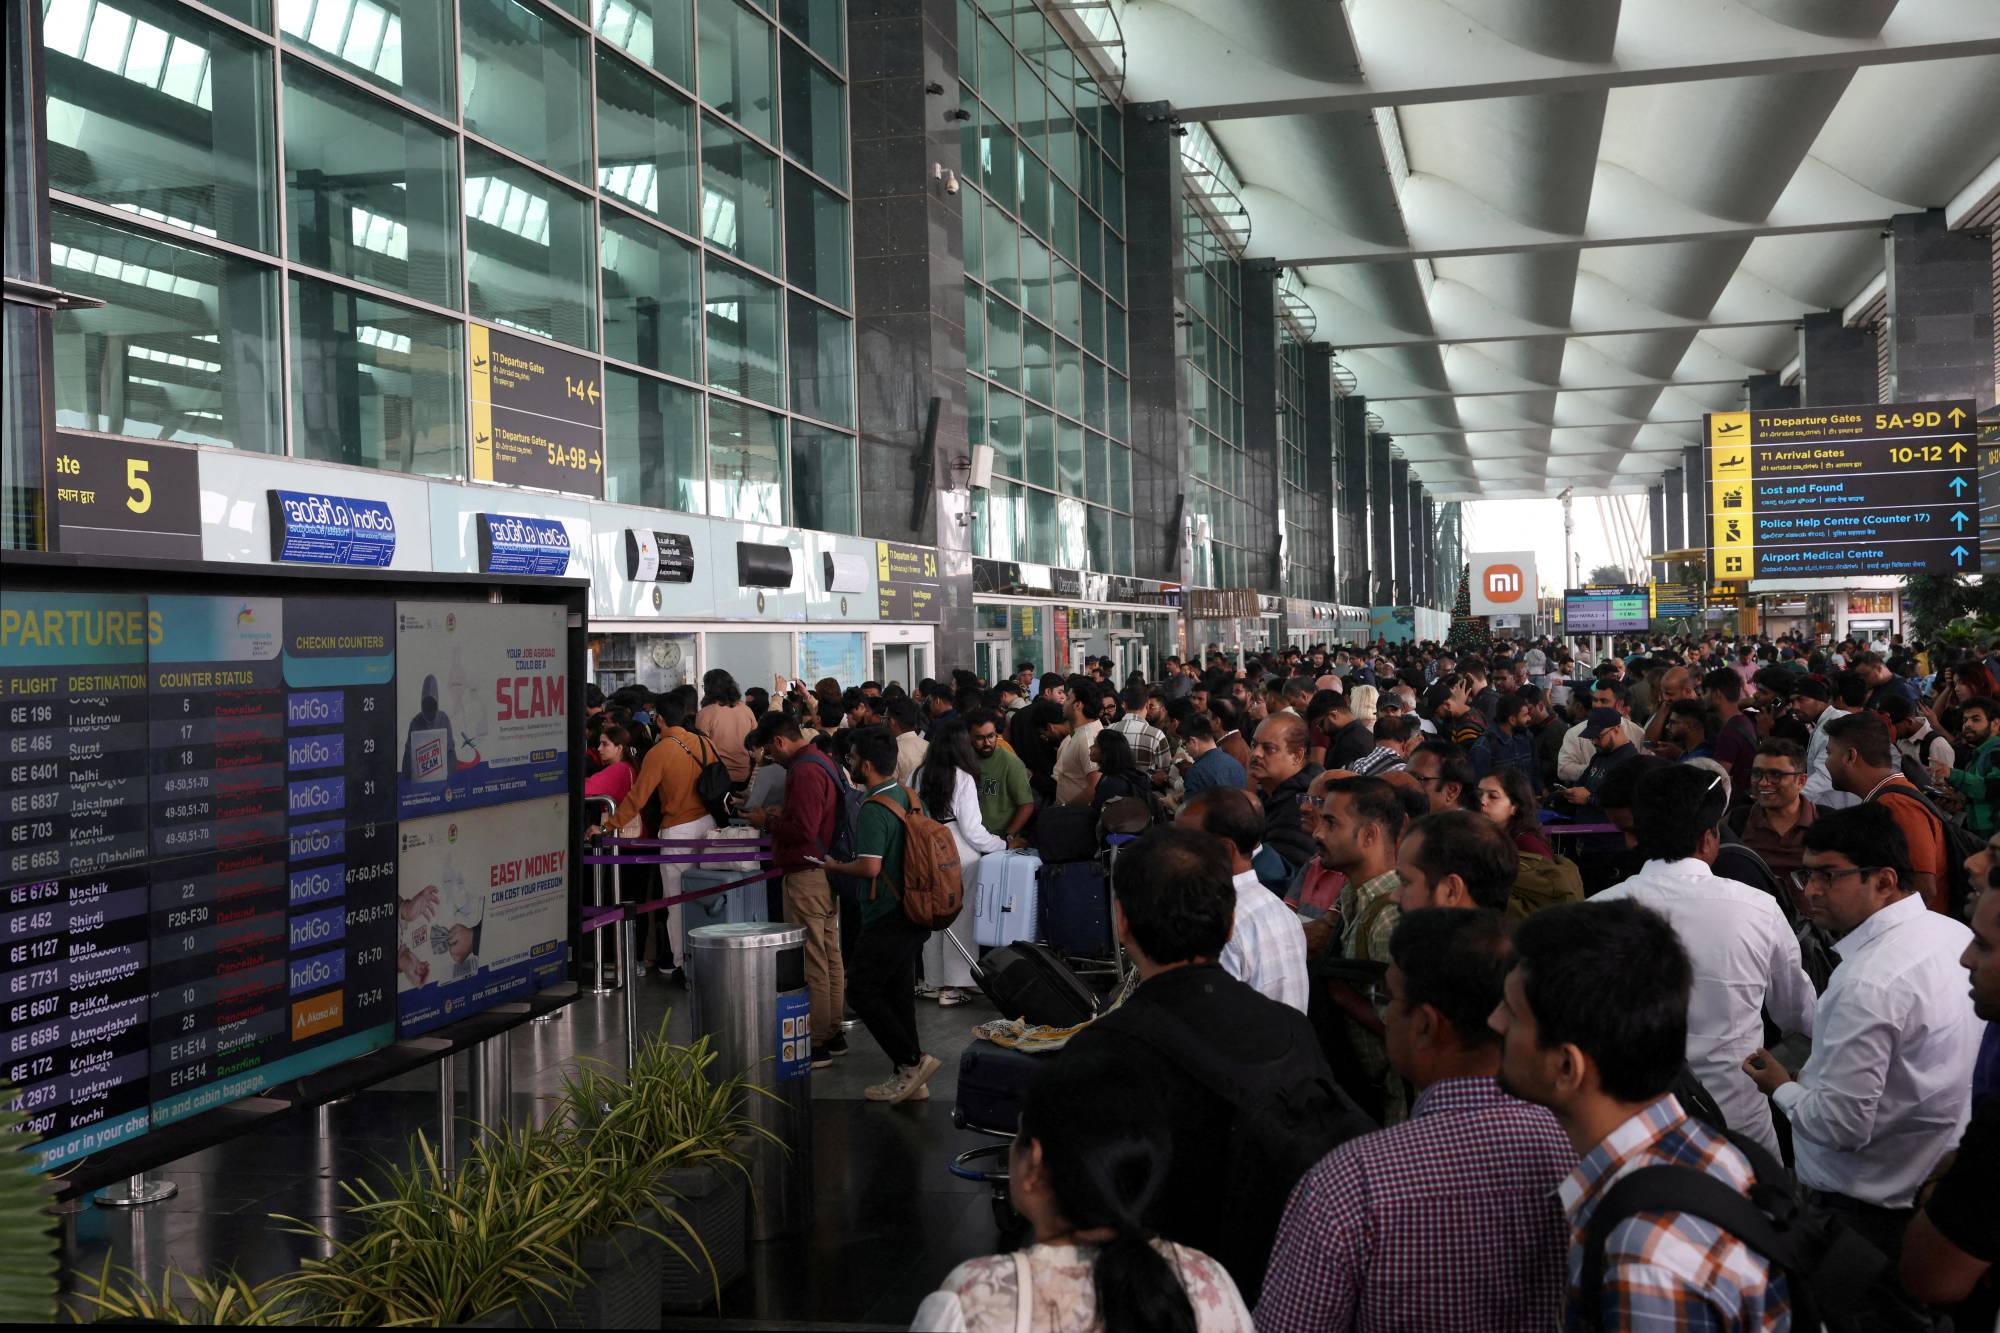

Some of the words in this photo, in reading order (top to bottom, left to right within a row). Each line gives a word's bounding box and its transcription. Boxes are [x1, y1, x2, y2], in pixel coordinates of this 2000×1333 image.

[492, 351, 500, 362] T1
[500, 353, 528, 370] Departure
[529, 361, 545, 375] Gates
[566, 376, 585, 401] 1-4
[1759, 418, 1771, 428] T1
[1774, 416, 1828, 429] Departure
[1830, 414, 1862, 425] Gates
[1875, 411, 1941, 430] 5A-9D
[495, 427, 502, 438] T1
[502, 429, 531, 445] Departure
[531, 435, 547, 447] Gates
[547, 443, 587, 471] 5A-9B
[1760, 450, 1772, 461] T1
[1776, 449, 1811, 460] Arrival
[1813, 448, 1845, 459] Gates
[1889, 446, 1943, 464] 10-12
[79, 489, 96, 504] द्वार
[126, 458, 153, 515] 5
[1760, 485, 1784, 496] Lost
[1786, 484, 1807, 494] and
[1809, 482, 1844, 493] Found
[350, 507, 393, 531] IndiGo
[1760, 518, 1793, 529] Police
[1795, 517, 1820, 529] Help
[1823, 516, 1860, 527] Centre
[1863, 514, 1911, 527] (Counter
[1913, 512, 1931, 525] 17)
[536, 527, 568, 547] IndiGo
[923, 552, 938, 578] 5A
[1761, 552, 1800, 565] Airport
[1802, 550, 1844, 562] Medical
[1847, 549, 1884, 560] Centre
[655, 592, 660, 605] 3
[295, 636, 336, 650] CHECKIN
[337, 635, 385, 649] COUNTERS
[506, 647, 521, 659] YOUR
[516, 660, 535, 671] COULD
[11, 677, 58, 696] FLIGHT
[68, 673, 147, 693] DESTINATION
[159, 672, 212, 689] COUNTER
[214, 670, 254, 687] STATUS
[363, 697, 375, 712] 25
[496, 674, 566, 721] SCAM
[11, 708, 27, 724] 6E
[30, 706, 53, 722] 196
[289, 698, 329, 721] IndiGo
[180, 725, 193, 739] 17
[11, 739, 27, 754] 6E
[30, 736, 53, 752] 465
[289, 741, 329, 763] IndiGo
[363, 739, 375, 754] 29
[180, 751, 193, 766] 18
[421, 757, 439, 773] SCAM
[11, 767, 27, 783] 6E
[30, 763, 59, 780] 6401
[165, 776, 209, 793] 49-50,51-70
[364, 781, 375, 795] 31
[11, 797, 27, 813] 6E
[30, 792, 60, 811] 6837
[289, 785, 329, 808] IndiGo
[165, 803, 209, 819] 49-50,51-70
[11, 826, 27, 842] 6E
[30, 822, 53, 840] 703
[165, 829, 209, 845] 49-50,51-70
[364, 822, 376, 839] 33
[290, 829, 330, 857] IndiGo
[11, 856, 27, 872] 6E
[30, 850, 61, 870] 6653
[490, 858, 523, 888] EASY
[525, 849, 567, 879] MONEY
[182, 884, 195, 899] 22
[290, 870, 330, 896] IndiGo
[491, 890, 504, 904] CAN
[504, 887, 520, 902] COST
[520, 883, 536, 898] YOUR
[536, 876, 563, 894] FREEDOM
[11, 888, 27, 904] 6E
[11, 917, 27, 933] 6E
[30, 912, 53, 930] 452
[168, 906, 209, 928] F26-F30
[290, 912, 330, 939] IndiGo
[11, 947, 27, 963] 6E
[30, 938, 59, 959] 1127
[182, 938, 195, 953] 10
[357, 946, 383, 966] 51-70
[290, 955, 330, 982] IndiGo
[11, 976, 27, 993] 6E
[30, 968, 59, 990] 7731
[182, 989, 195, 1004] 10
[357, 987, 383, 1008] 73-74
[11, 1006, 27, 1023] 6E
[30, 996, 61, 1018] 6507
[11, 1037, 27, 1053] 6E
[30, 1028, 61, 1048] 6595
[170, 1039, 207, 1062] E1-E14
[11, 1066, 27, 1083] 6E
[30, 1056, 54, 1077] 172
[170, 1066, 207, 1088] E1-E14
[27, 1084, 57, 1108] 2973
[67, 1140, 81, 1157] or
[83, 1134, 94, 1150] in
[96, 1124, 124, 1149] your
[171, 1098, 191, 1118] and
[193, 1088, 221, 1112] cabin
